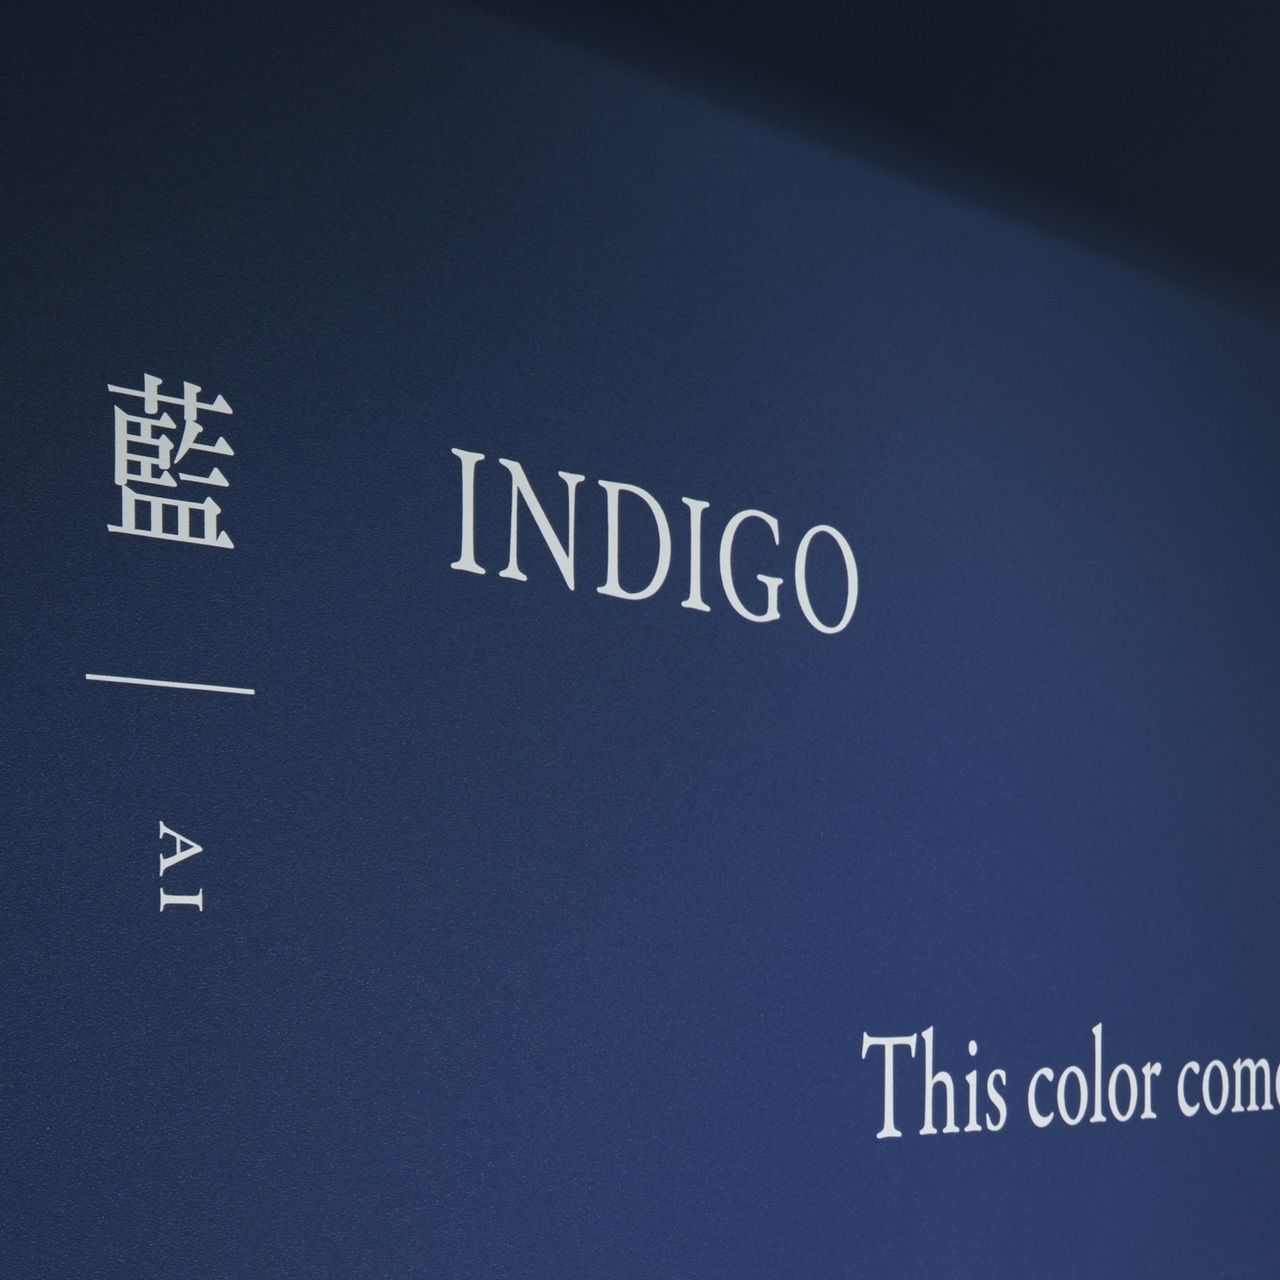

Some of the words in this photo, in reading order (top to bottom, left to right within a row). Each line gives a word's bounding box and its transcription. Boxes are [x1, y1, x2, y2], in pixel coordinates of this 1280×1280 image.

[107, 374, 234, 549] 藍
[451, 448, 859, 634] INDIGO
[159, 820, 204, 913] AI
[861, 1025, 1008, 1139] This
[1028, 1022, 1162, 1126] color
